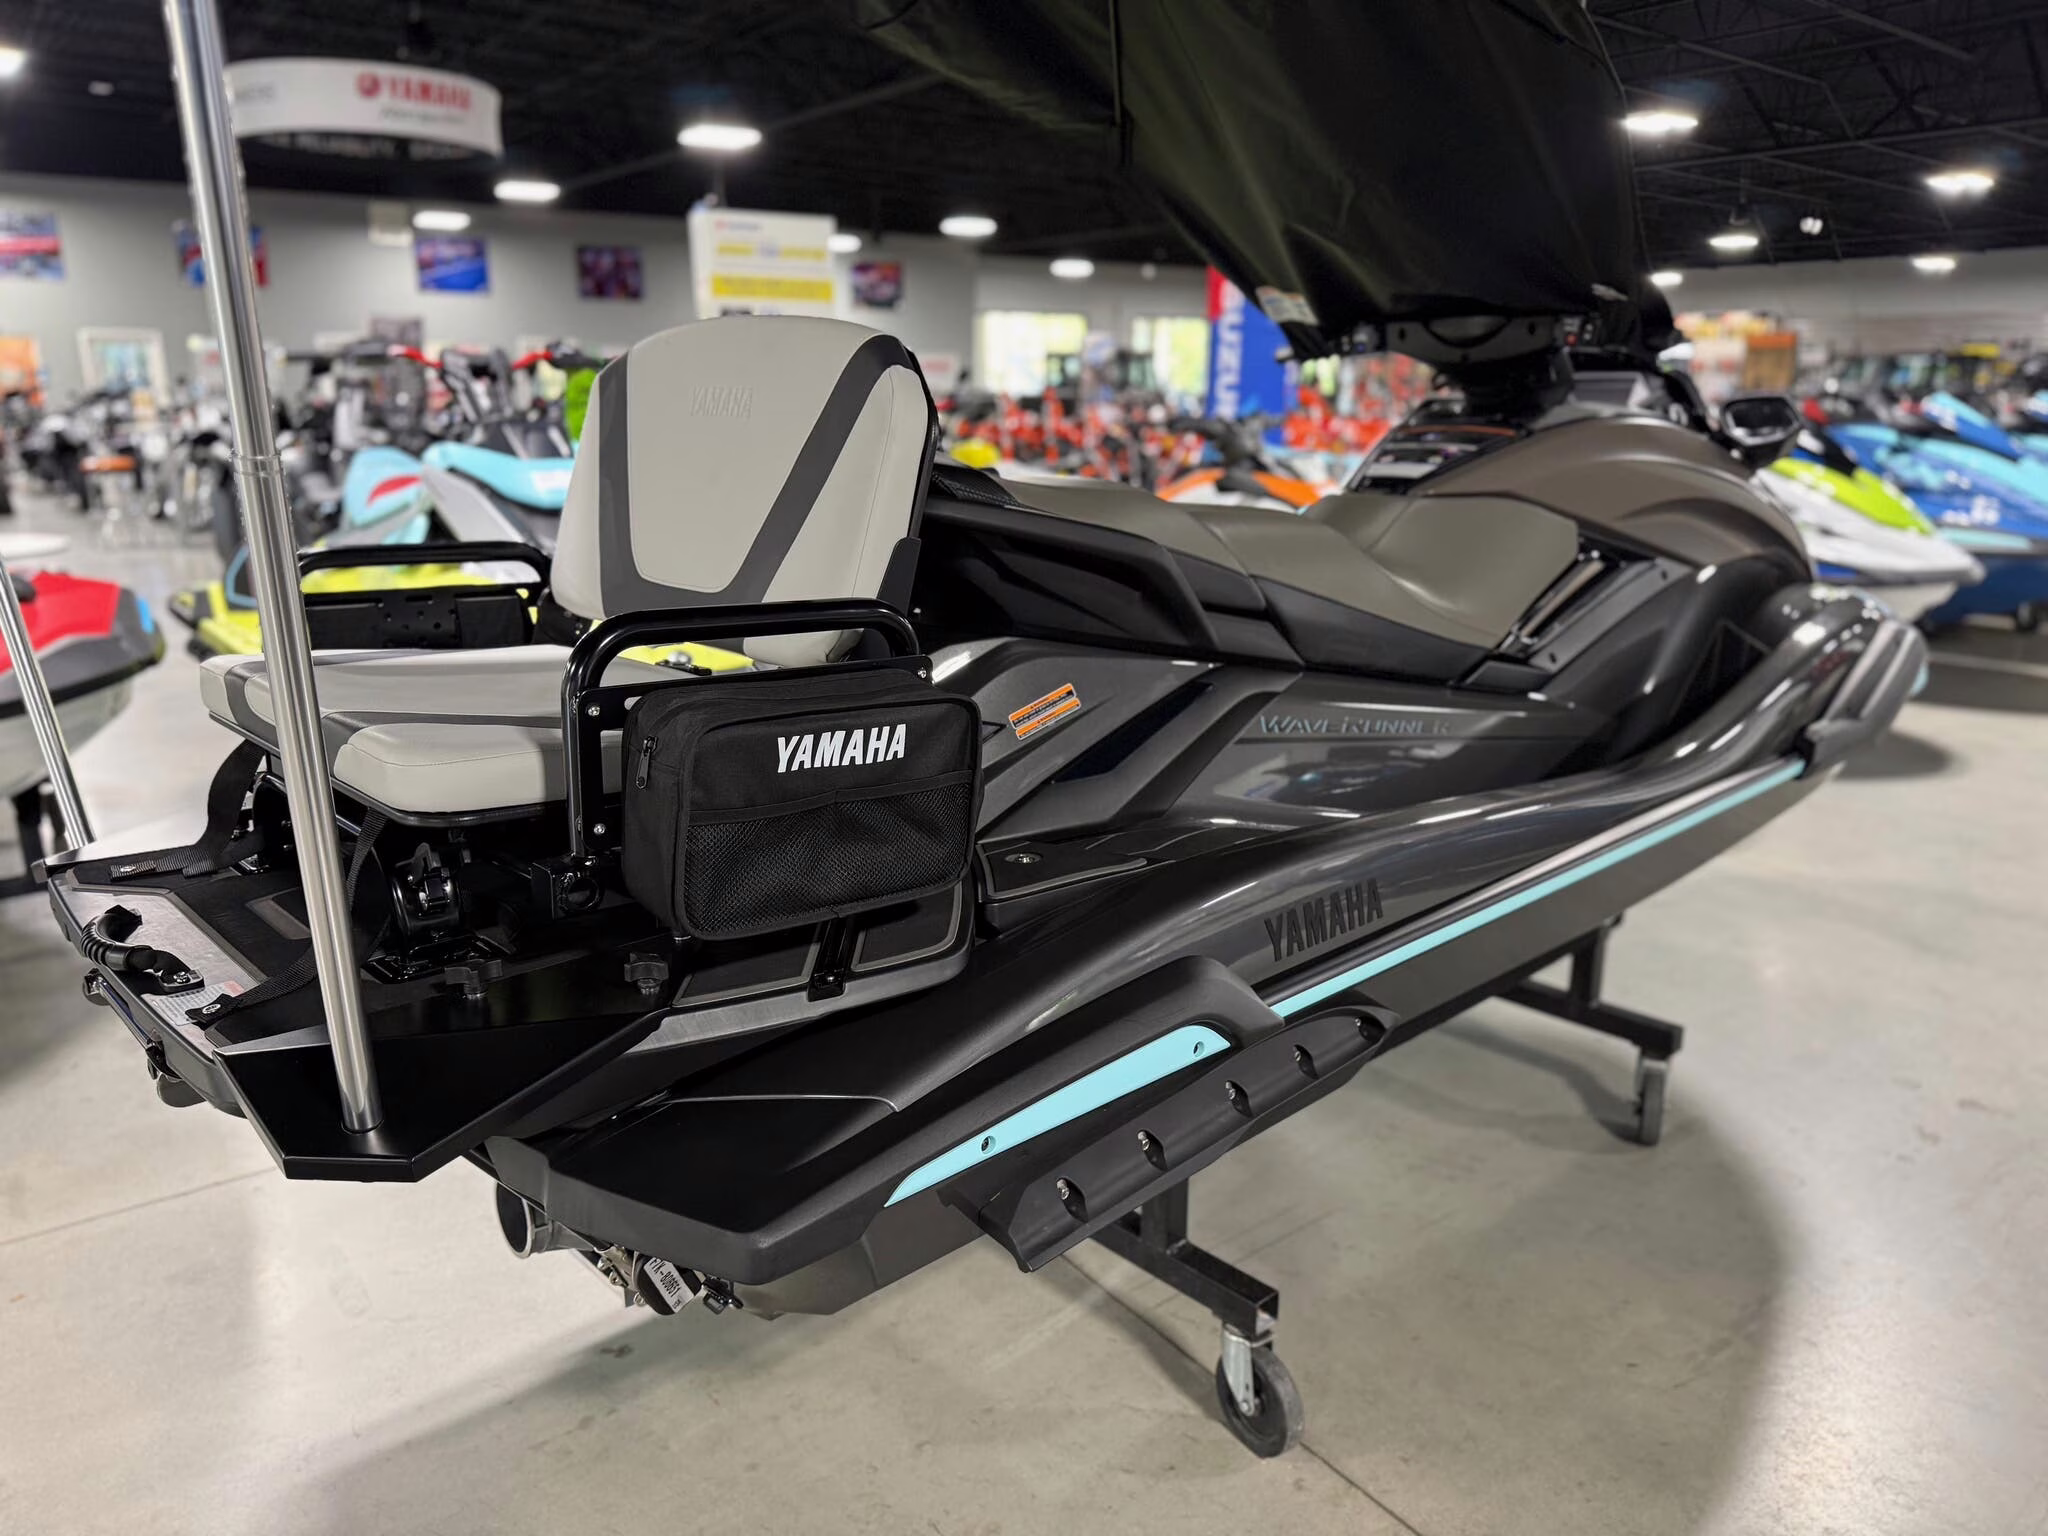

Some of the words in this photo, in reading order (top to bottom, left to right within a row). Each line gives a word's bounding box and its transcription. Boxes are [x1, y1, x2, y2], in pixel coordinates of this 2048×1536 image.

[1215, 280, 1245, 421] SUZUK
[689, 384, 753, 419] YAMAHA
[777, 723, 906, 773] YAMAHA
[1264, 878, 1383, 962] YAMAHA
